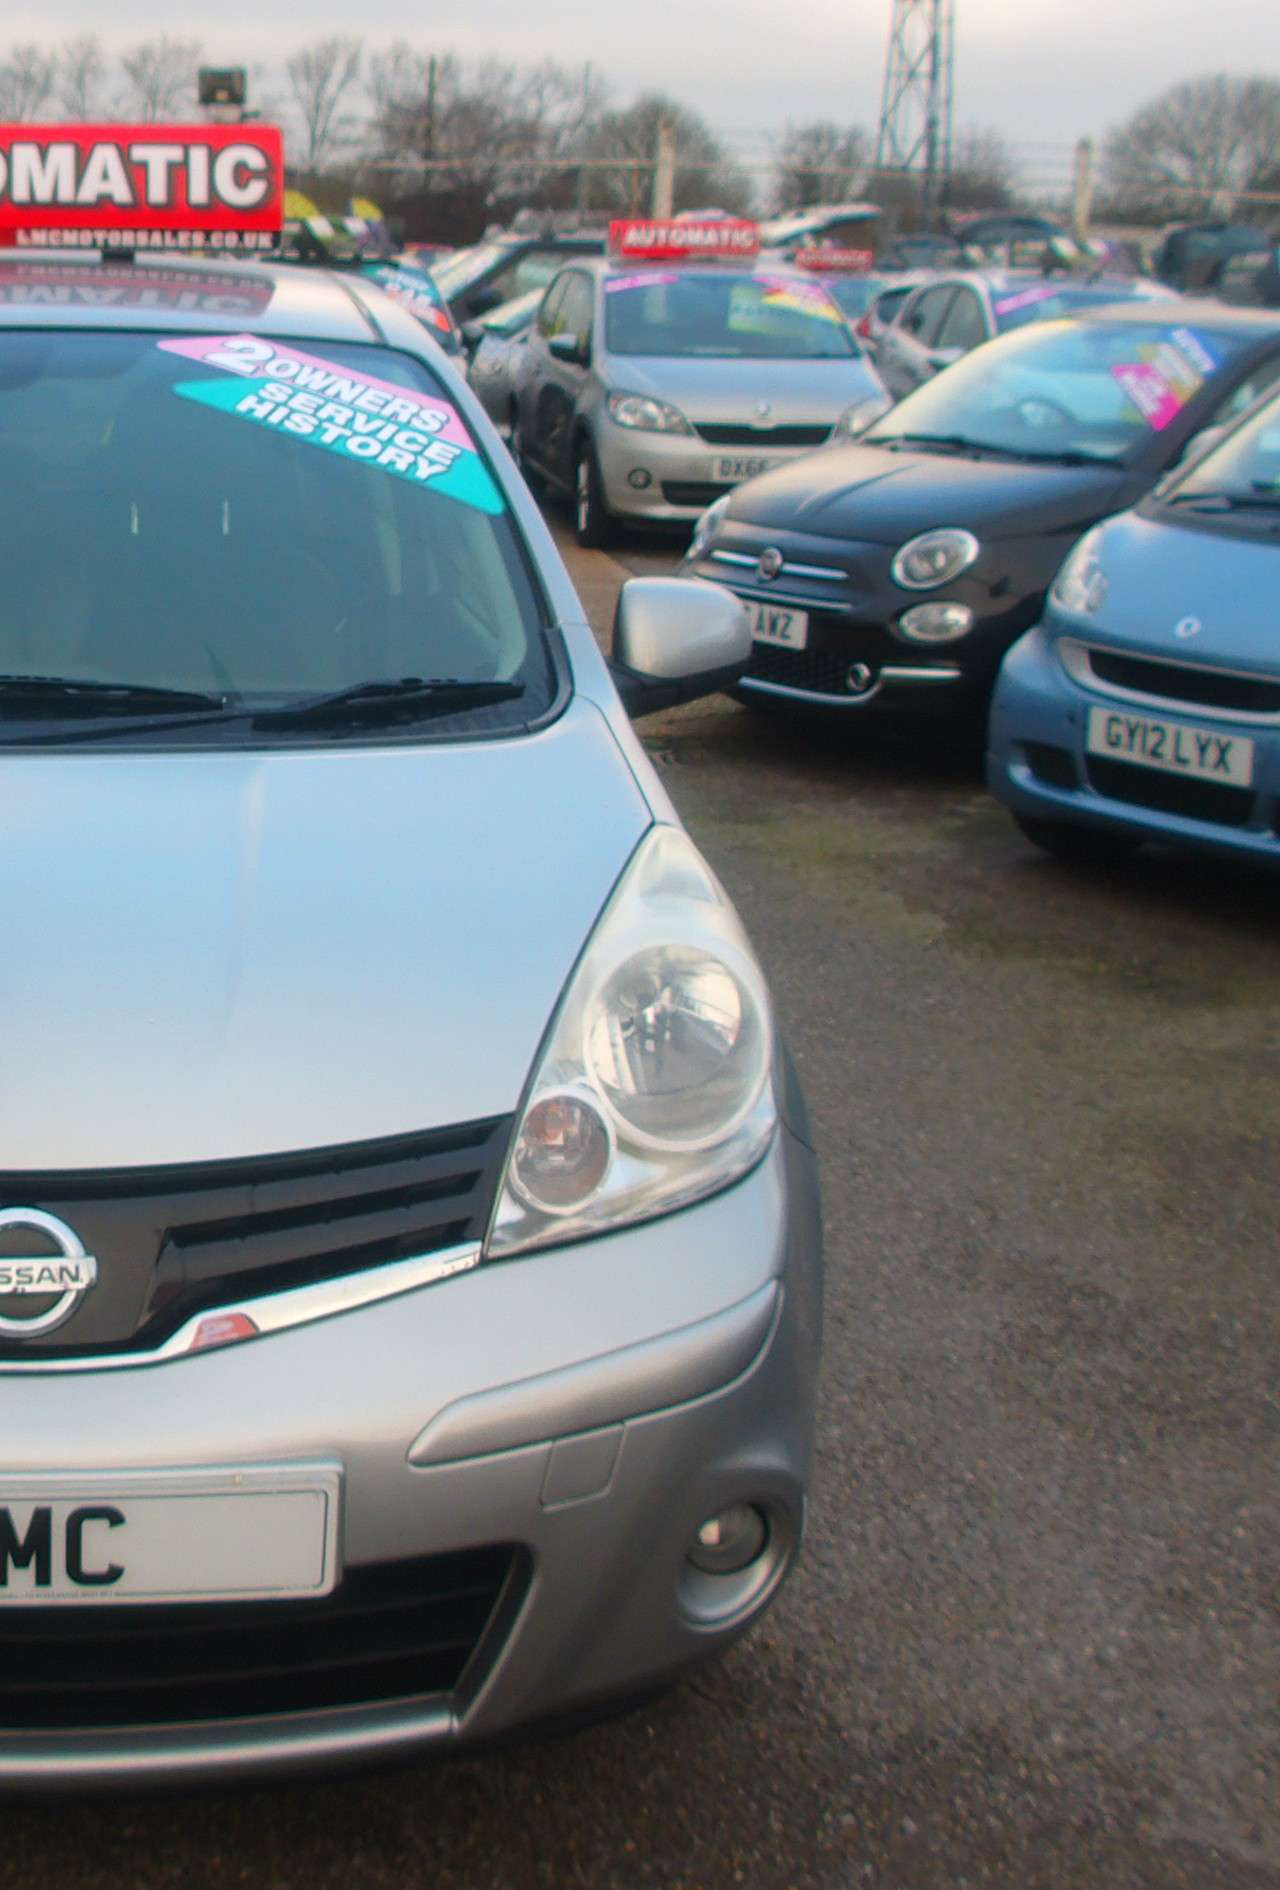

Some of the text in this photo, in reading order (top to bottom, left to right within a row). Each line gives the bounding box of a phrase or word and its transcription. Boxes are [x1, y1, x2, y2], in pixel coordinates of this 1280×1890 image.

[624, 225, 757, 248] AUTOMATIC
[205, 338, 450, 433] 2 OWNERS
[258, 381, 462, 467] SERVICE
[235, 394, 451, 480] HISTORY
[1106, 716, 1233, 774] GY12 LYX
